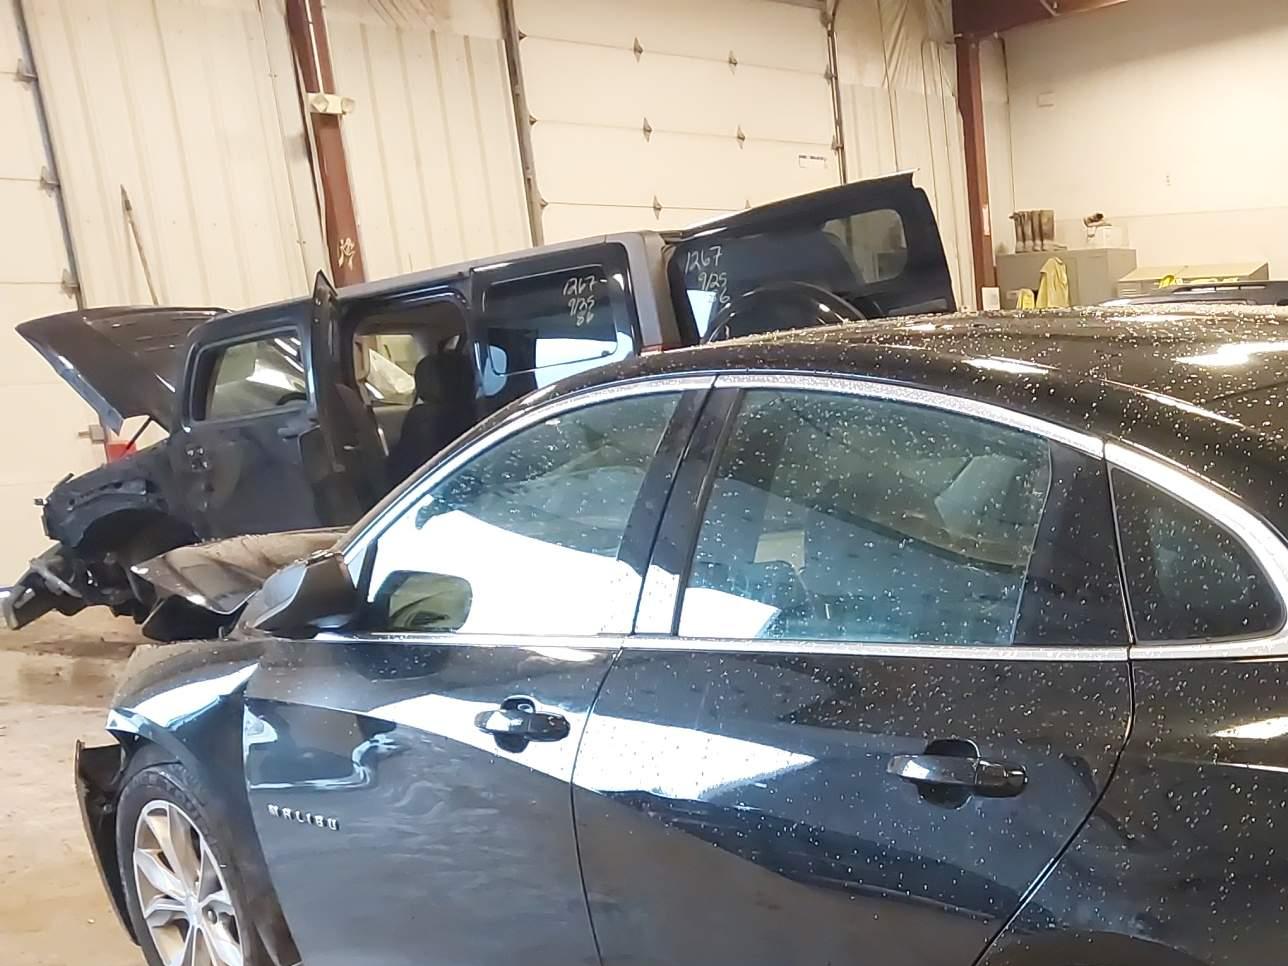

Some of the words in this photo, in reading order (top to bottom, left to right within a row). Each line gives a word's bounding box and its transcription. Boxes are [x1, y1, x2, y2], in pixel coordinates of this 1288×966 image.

[685, 245, 723, 274] 1267
[563, 275, 597, 295] 1267
[699, 271, 727, 292] 9/25
[267, 804, 340, 831] MALIBU
